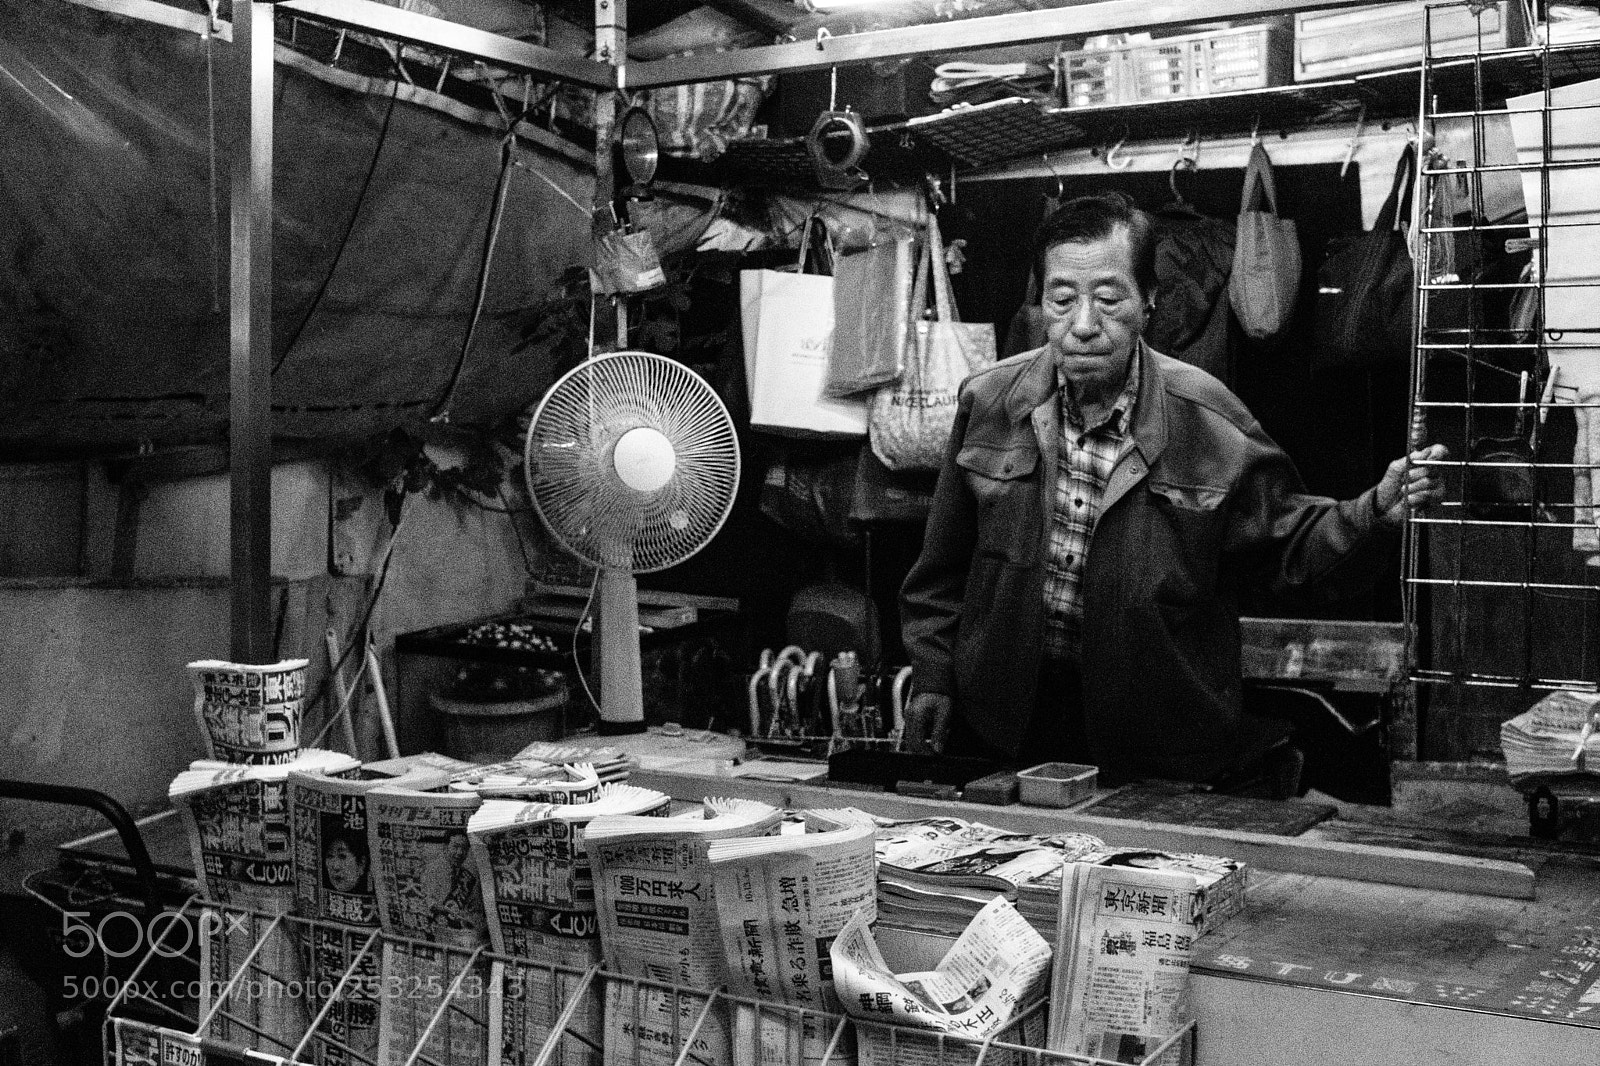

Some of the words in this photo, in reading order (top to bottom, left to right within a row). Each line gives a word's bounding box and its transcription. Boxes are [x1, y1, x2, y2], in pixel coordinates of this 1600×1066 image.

[342, 796, 366, 832] 小池
[205, 853, 224, 876] 田中
[245, 862, 291, 885] ALCS
[493, 857, 573, 904] 秋華賞
[777, 876, 800, 913] 急増
[1103, 886, 1169, 918] 東京新聞
[497, 903, 523, 926] 田中
